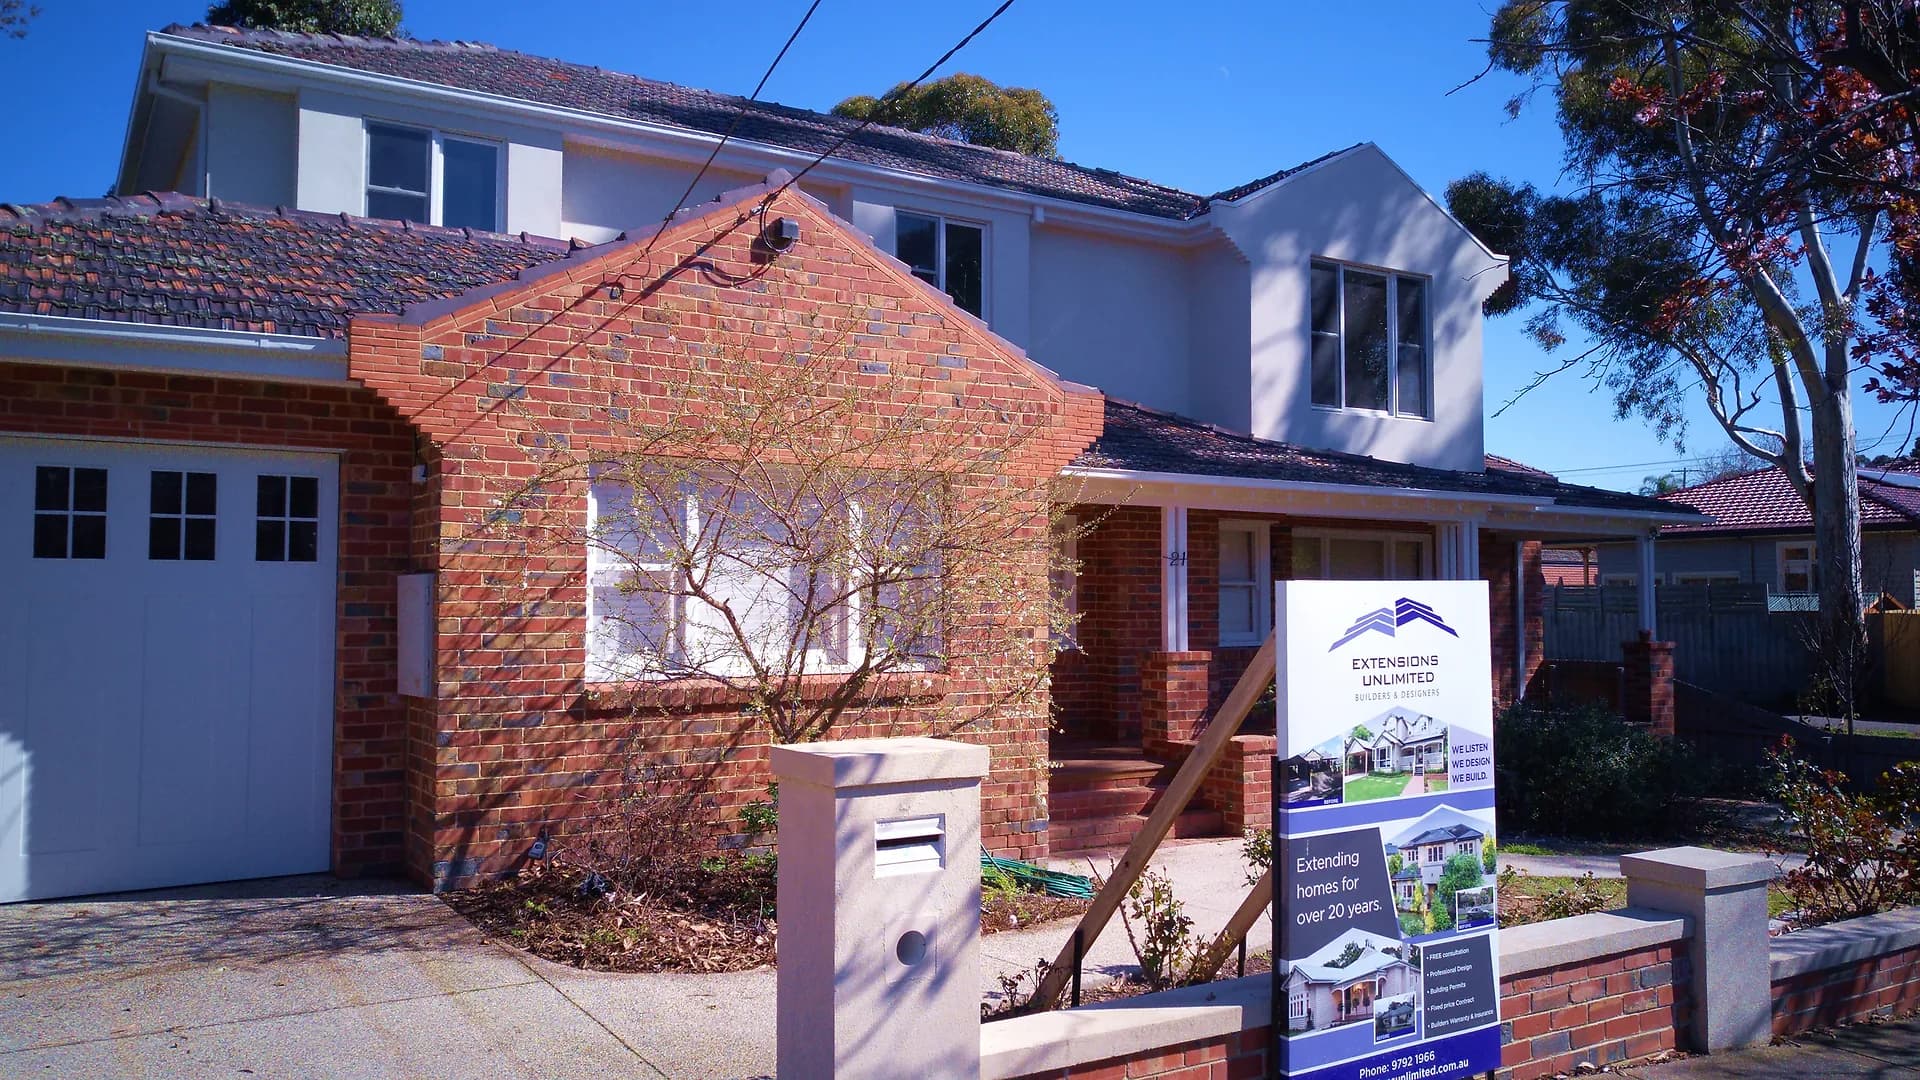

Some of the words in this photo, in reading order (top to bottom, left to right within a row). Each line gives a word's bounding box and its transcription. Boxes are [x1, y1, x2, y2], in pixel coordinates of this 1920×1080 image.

[1168, 551, 1187, 566] 21
[1352, 655, 1439, 670] EXTENSIONS
[1362, 671, 1435, 686] UNLIMITED
[1354, 691, 1391, 702] BUILDERS
[1393, 690, 1398, 700] &
[1400, 688, 1440, 699] DESIGNERS
[1451, 745, 1464, 754] WE
[1465, 743, 1489, 753] LISTEN
[1451, 759, 1465, 769] WE
[1465, 756, 1491, 768] DESIGN
[1451, 773, 1465, 783] WE
[1465, 771, 1488, 782] BUILD.
[1296, 851, 1360, 873] Extending
[1296, 881, 1339, 899] homes
[1341, 875, 1360, 892] for
[1296, 908, 1326, 925] over
[1327, 902, 1345, 920] 20
[1347, 899, 1383, 919] years.
[1429, 952, 1442, 961] FREE
[1442, 948, 1470, 958] consultation
[1429, 966, 1457, 977] Professional
[1456, 964, 1473, 973] Design
[1430, 985, 1449, 995] Building
[1449, 982, 1467, 991] Permits
[1430, 1004, 1443, 1012] Fixed
[1443, 1001, 1455, 1010] price
[1455, 996, 1475, 1006] Contract
[1430, 1019, 1449, 1029] Builders
[1449, 1015, 1470, 1025] Warranty
[1474, 1009, 1494, 1019] Insurance
[1359, 1064, 1390, 1079] Phone:
[1391, 1055, 1413, 1071] 9792
[1414, 1050, 1435, 1065] 1966
